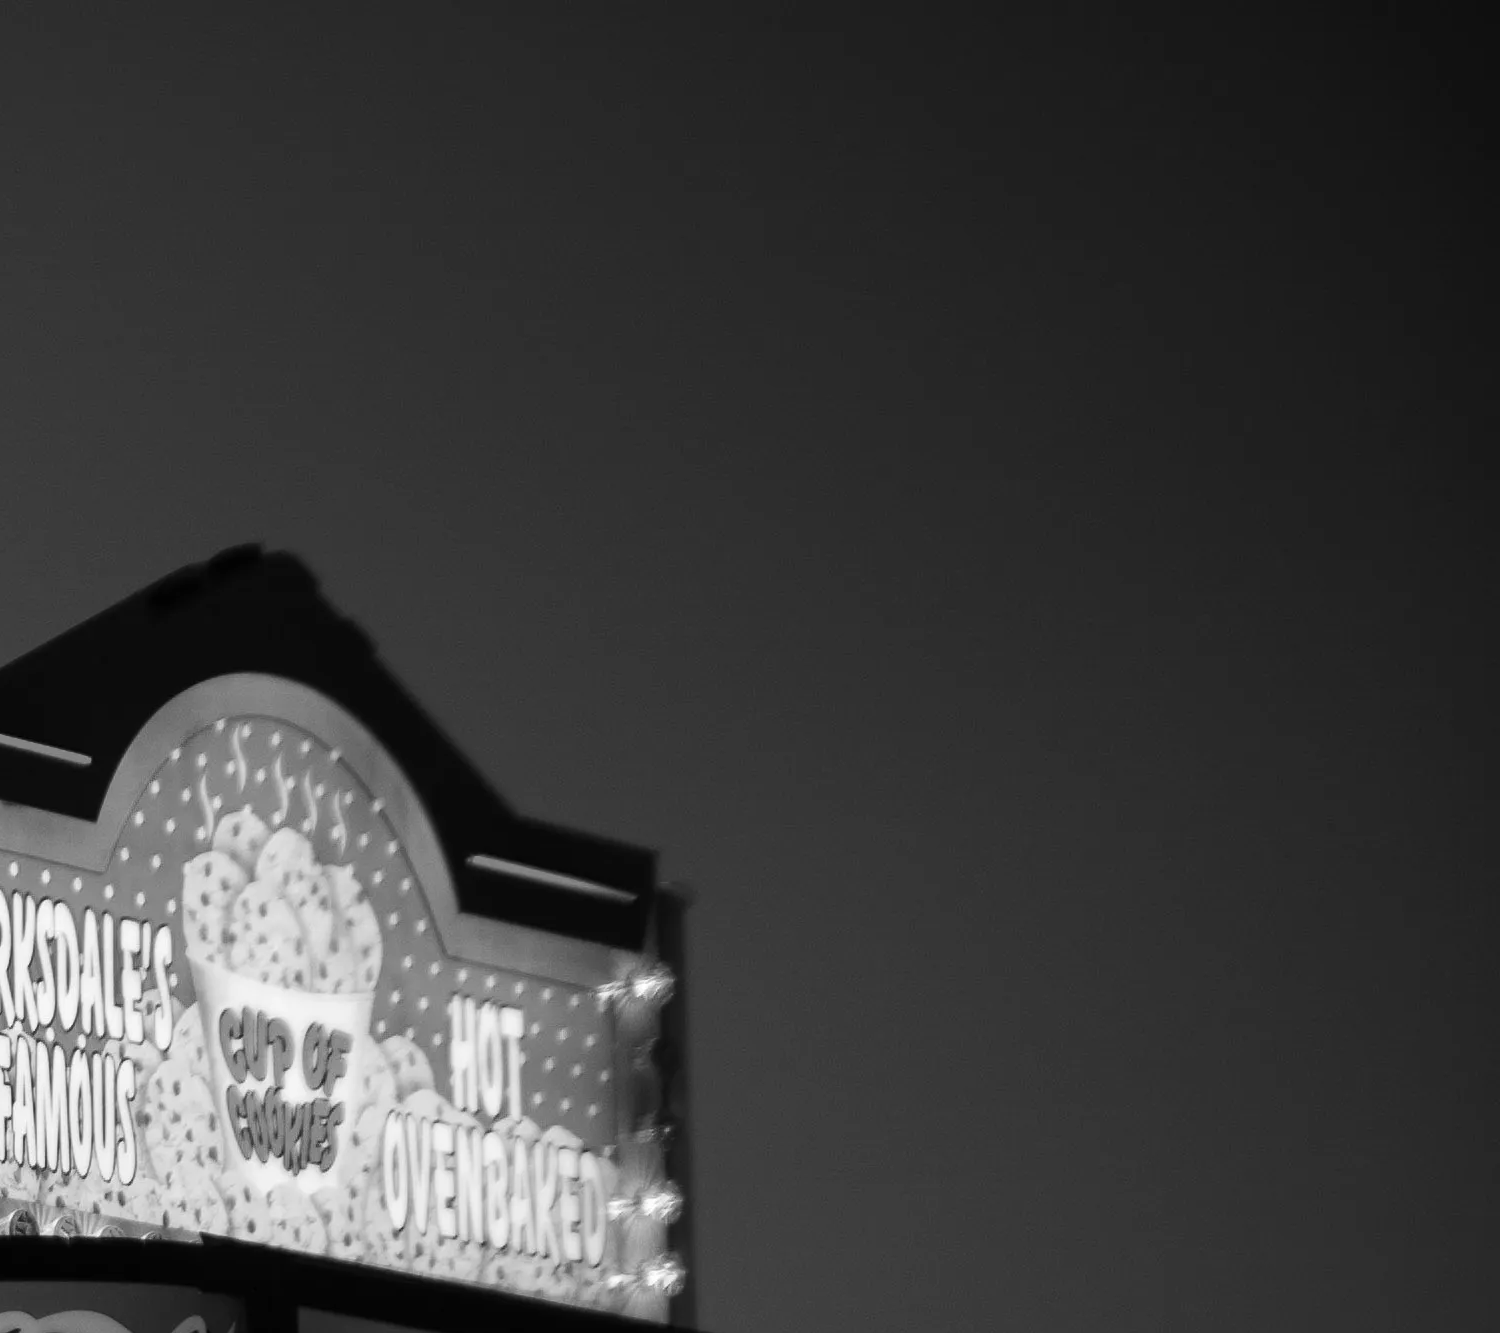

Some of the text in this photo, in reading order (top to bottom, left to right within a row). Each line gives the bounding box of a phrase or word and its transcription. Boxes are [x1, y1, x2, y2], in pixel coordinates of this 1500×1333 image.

[218, 1005, 351, 1093] CUP OF
[449, 995, 524, 1121] HOT
[226, 1085, 345, 1176] COOKIES
[383, 1112, 609, 1269] OVENBAKED
